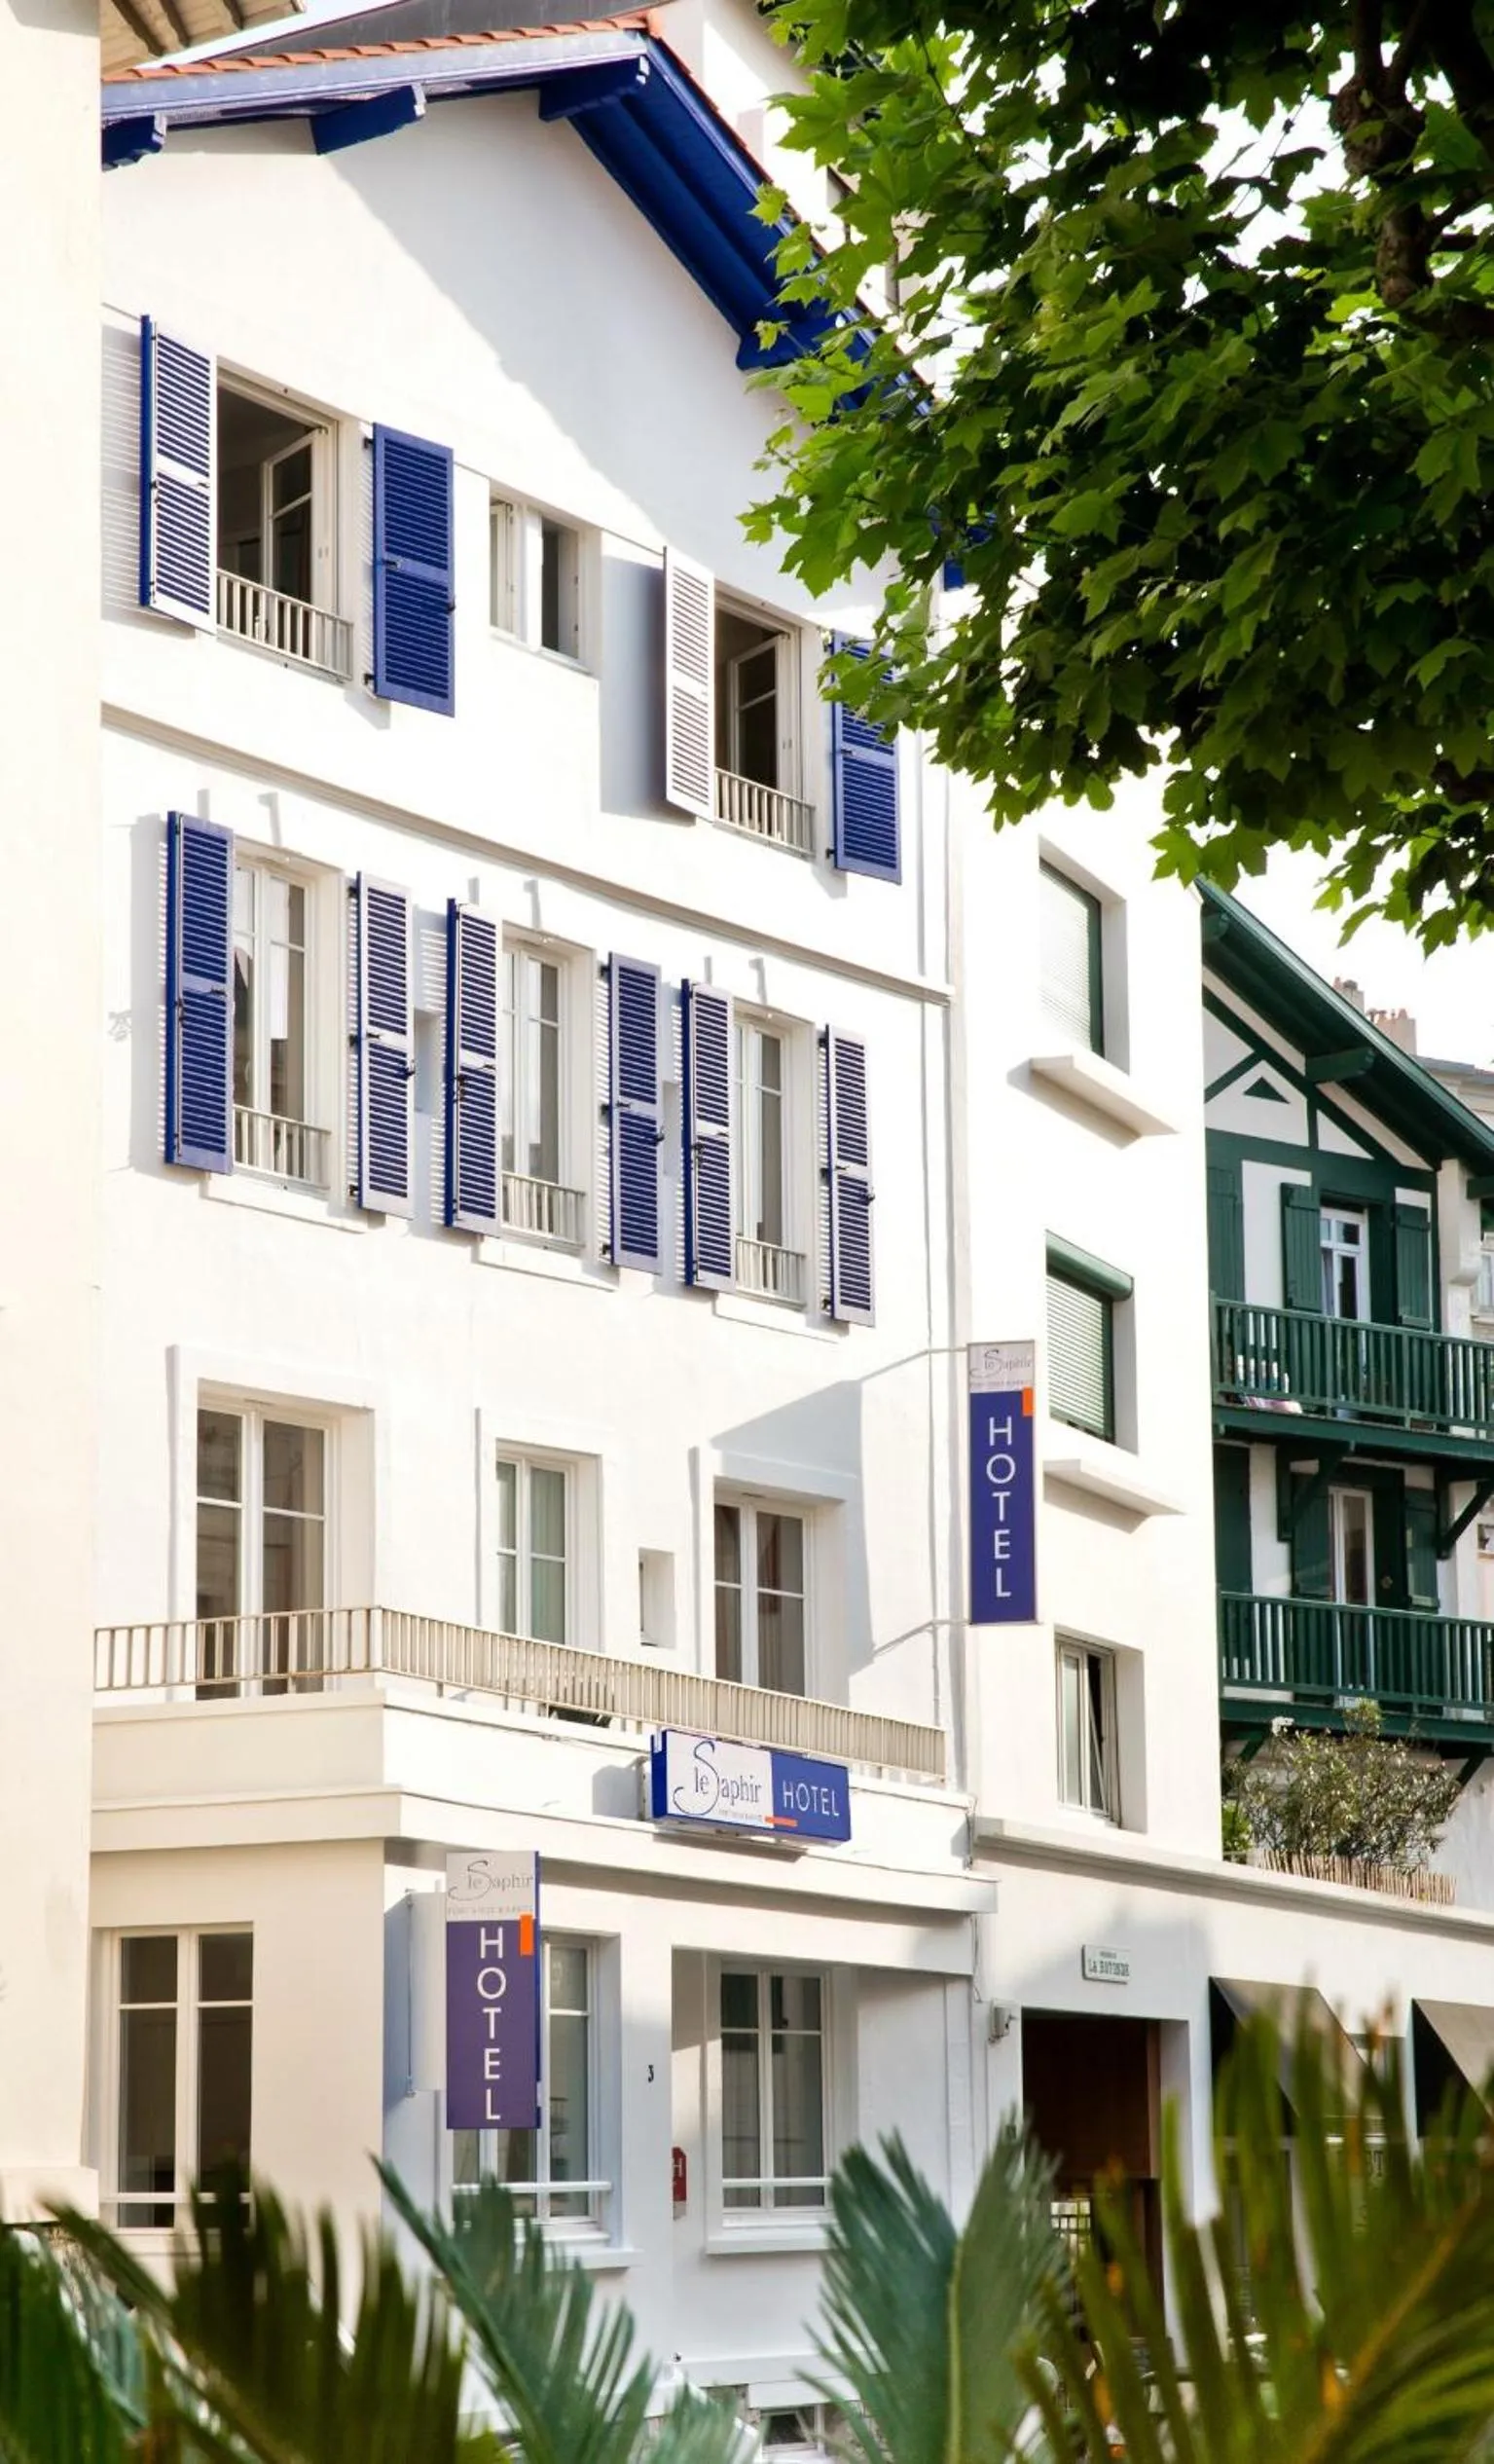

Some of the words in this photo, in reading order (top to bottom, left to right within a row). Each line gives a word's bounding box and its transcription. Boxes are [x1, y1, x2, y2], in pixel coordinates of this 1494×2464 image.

[986, 1416, 1016, 1599] HOTEL
[673, 1740, 762, 1816] Saphir
[694, 1767, 710, 1795] le
[782, 1780, 840, 1818] HOTEL
[448, 1859, 533, 1901] Saphir
[476, 1927, 507, 2121] HOTEL
